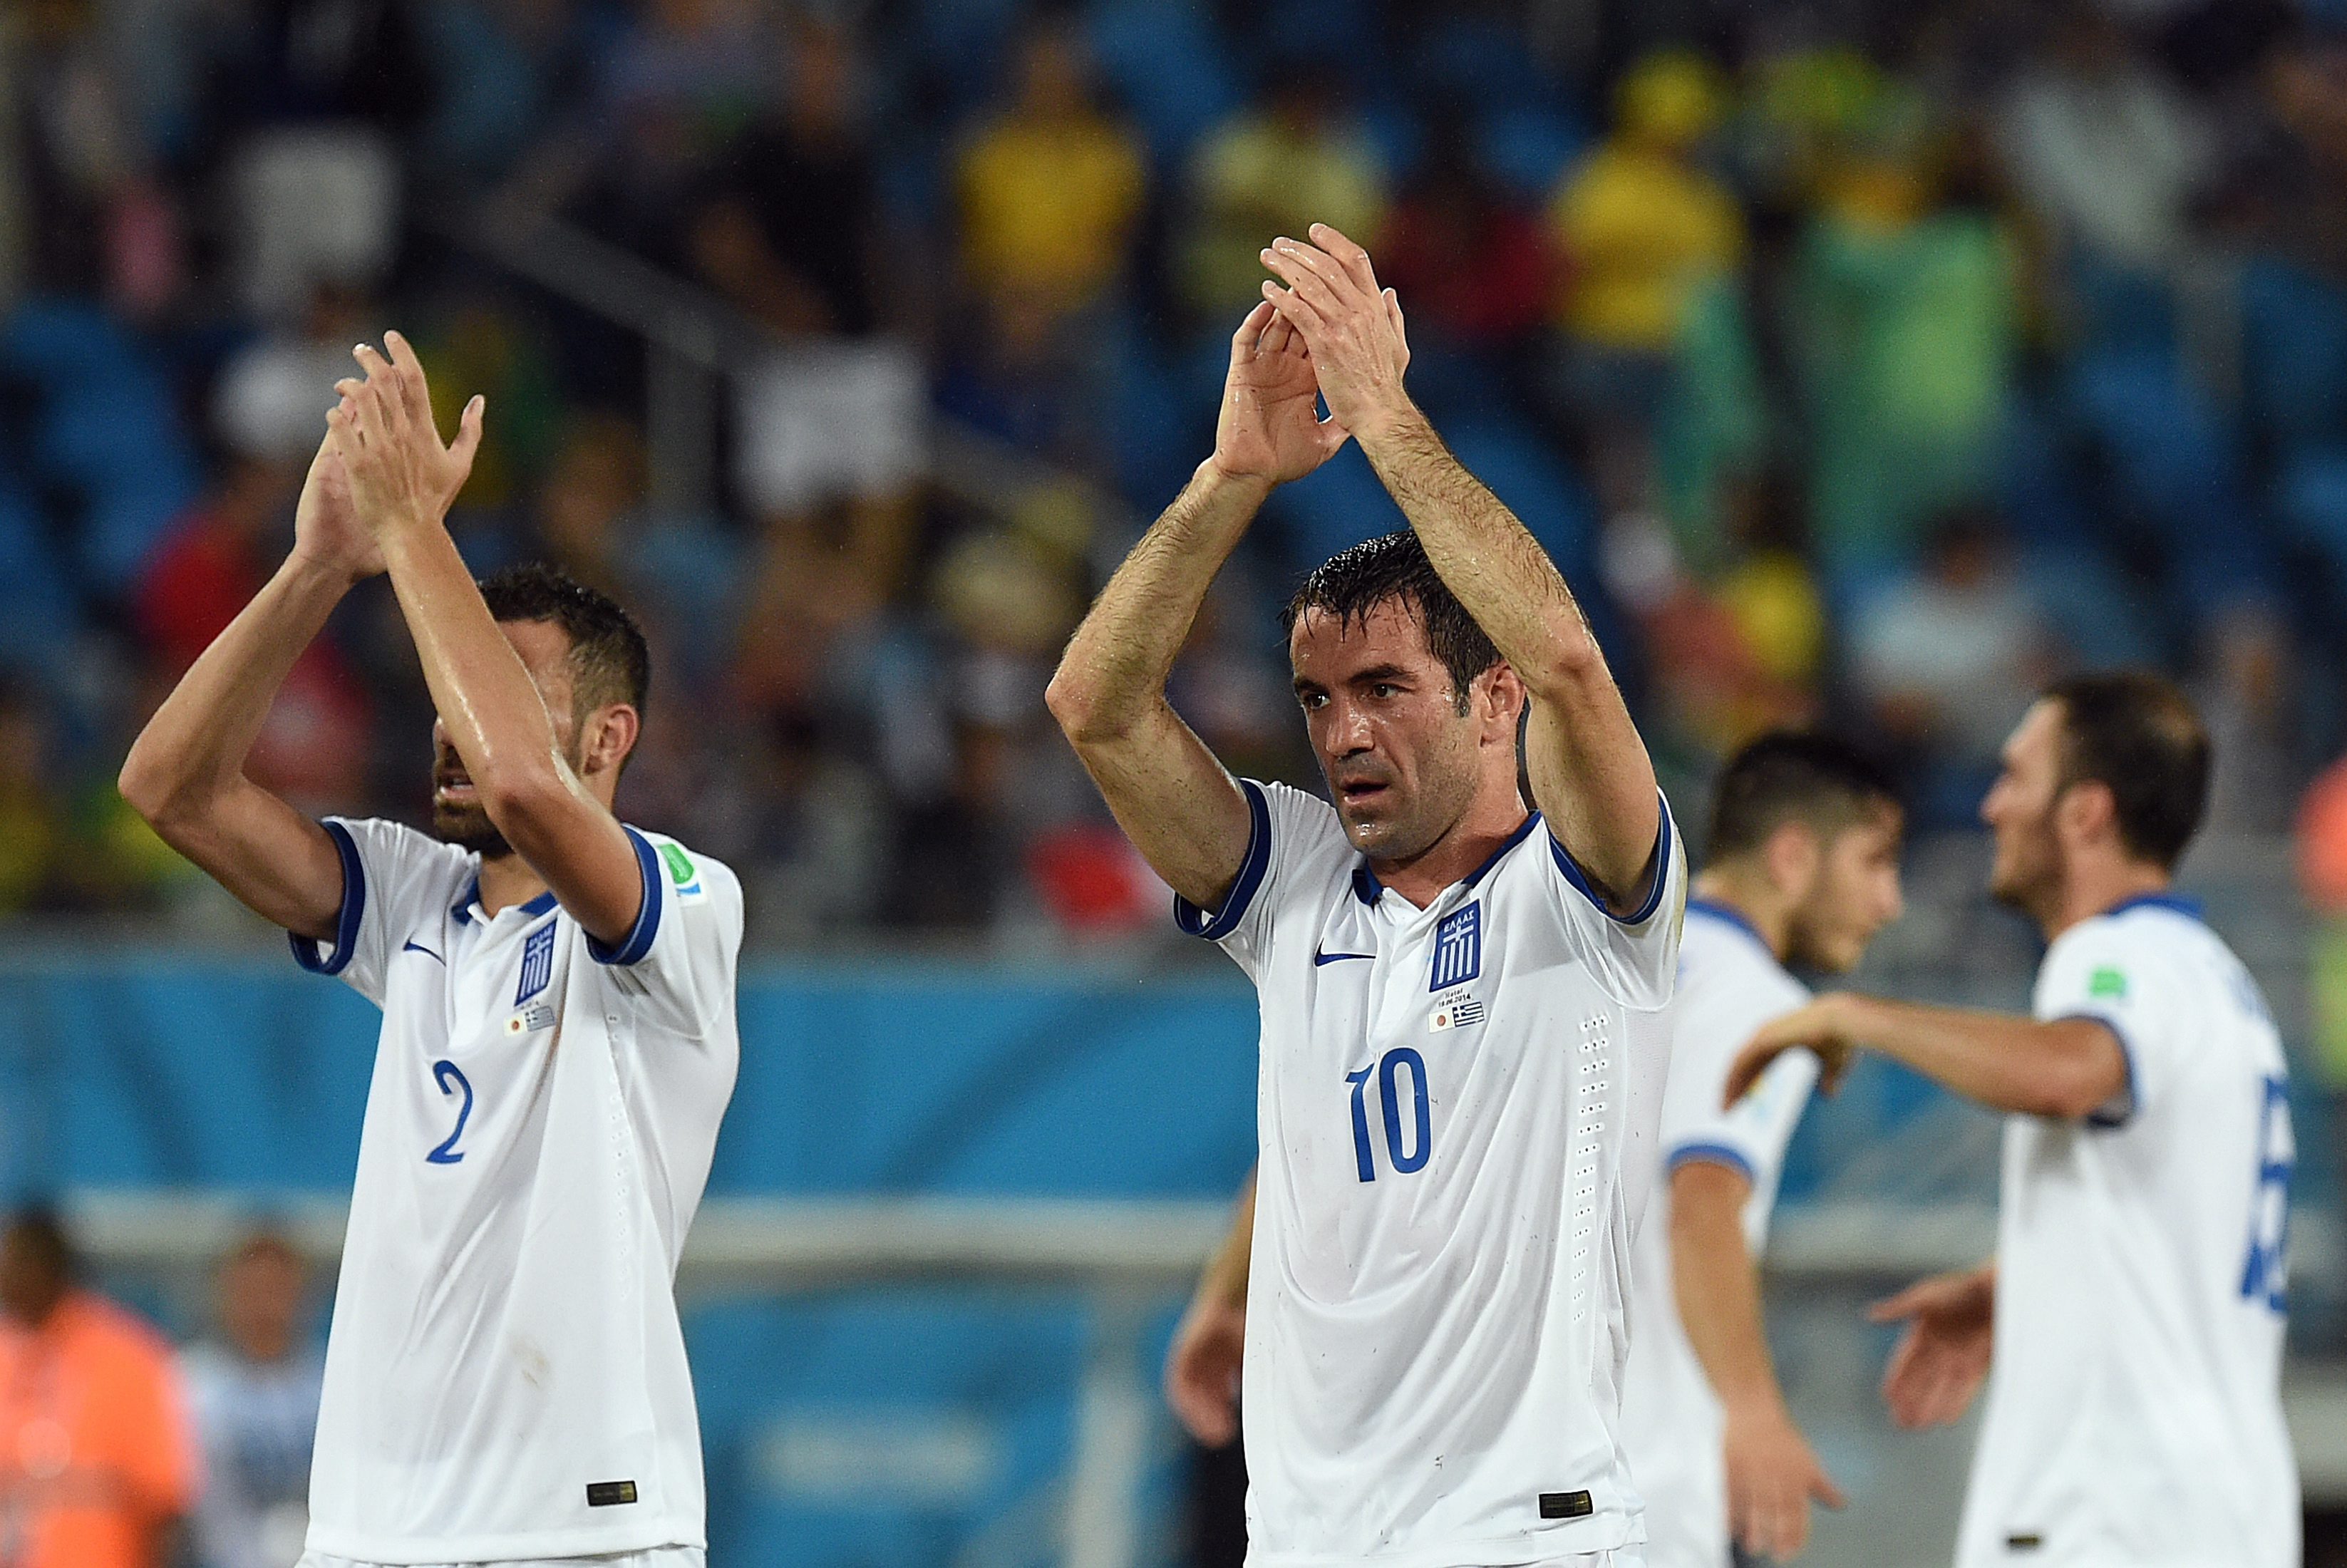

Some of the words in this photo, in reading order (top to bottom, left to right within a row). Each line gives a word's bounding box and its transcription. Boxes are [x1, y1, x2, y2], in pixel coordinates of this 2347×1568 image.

[1443, 909, 1475, 933] ΕΛΛΑΣ
[425, 1060, 473, 1164] 2
[1344, 1047, 1432, 1182] 10
